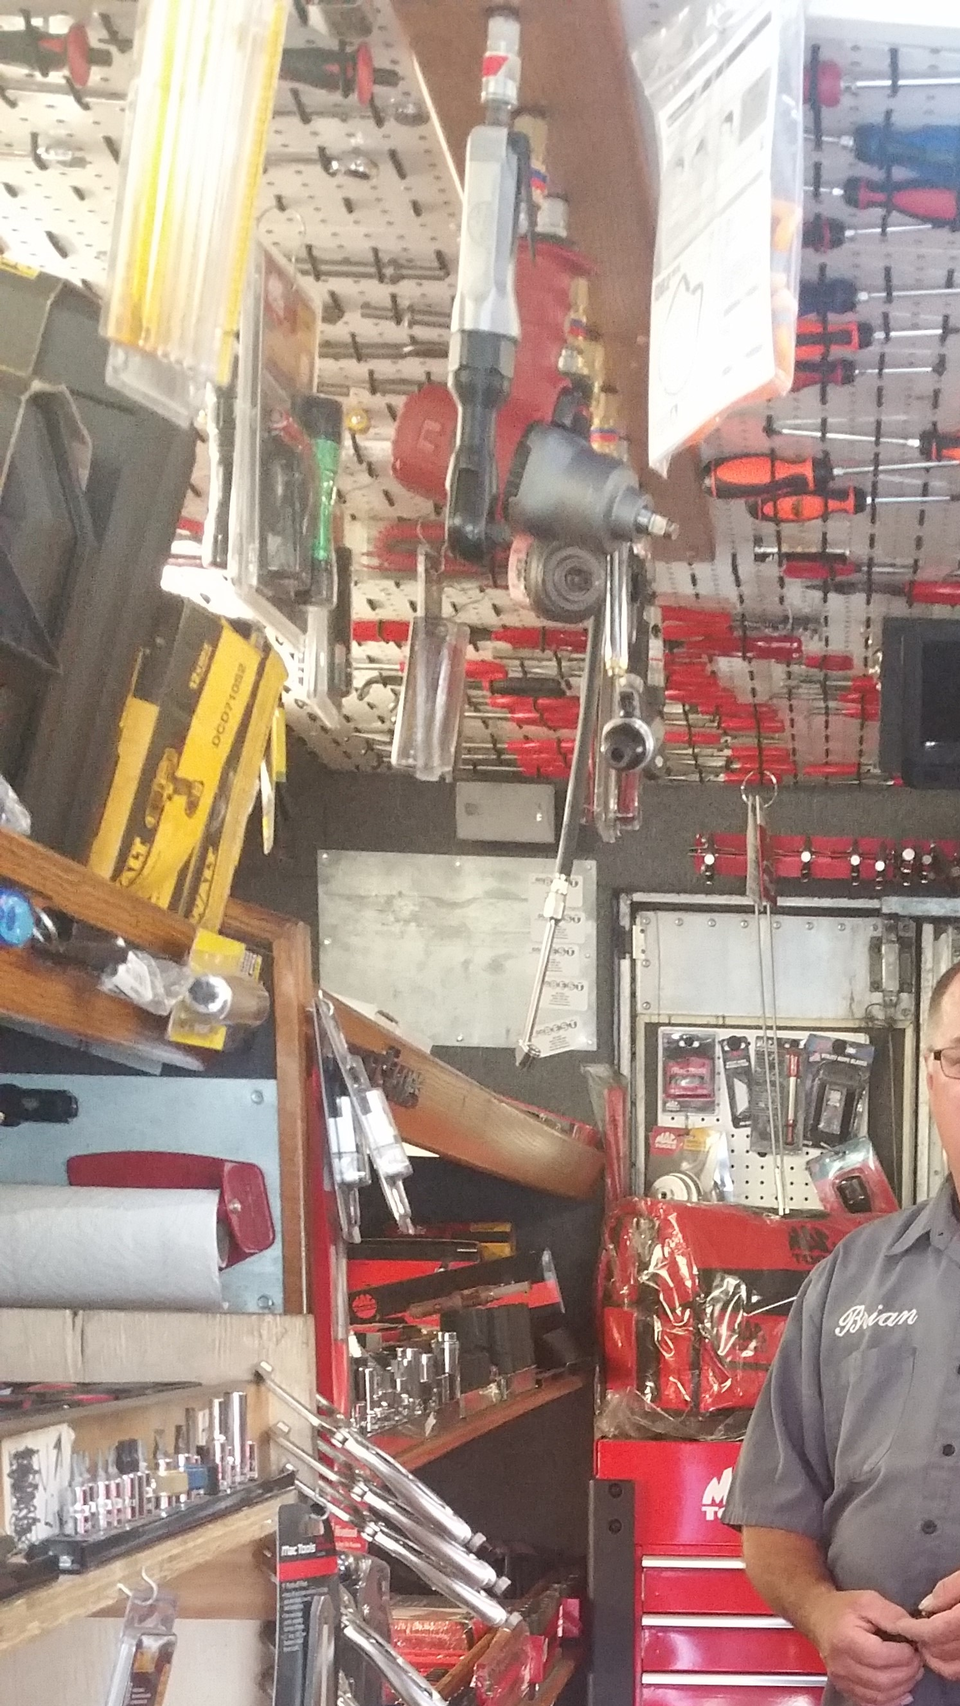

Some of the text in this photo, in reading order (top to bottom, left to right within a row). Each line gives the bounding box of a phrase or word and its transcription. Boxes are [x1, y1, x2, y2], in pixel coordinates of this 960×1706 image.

[119, 836, 150, 887] ALT
[834, 1304, 919, 1338] Brian
[281, 1542, 317, 1557] Mac Tools
